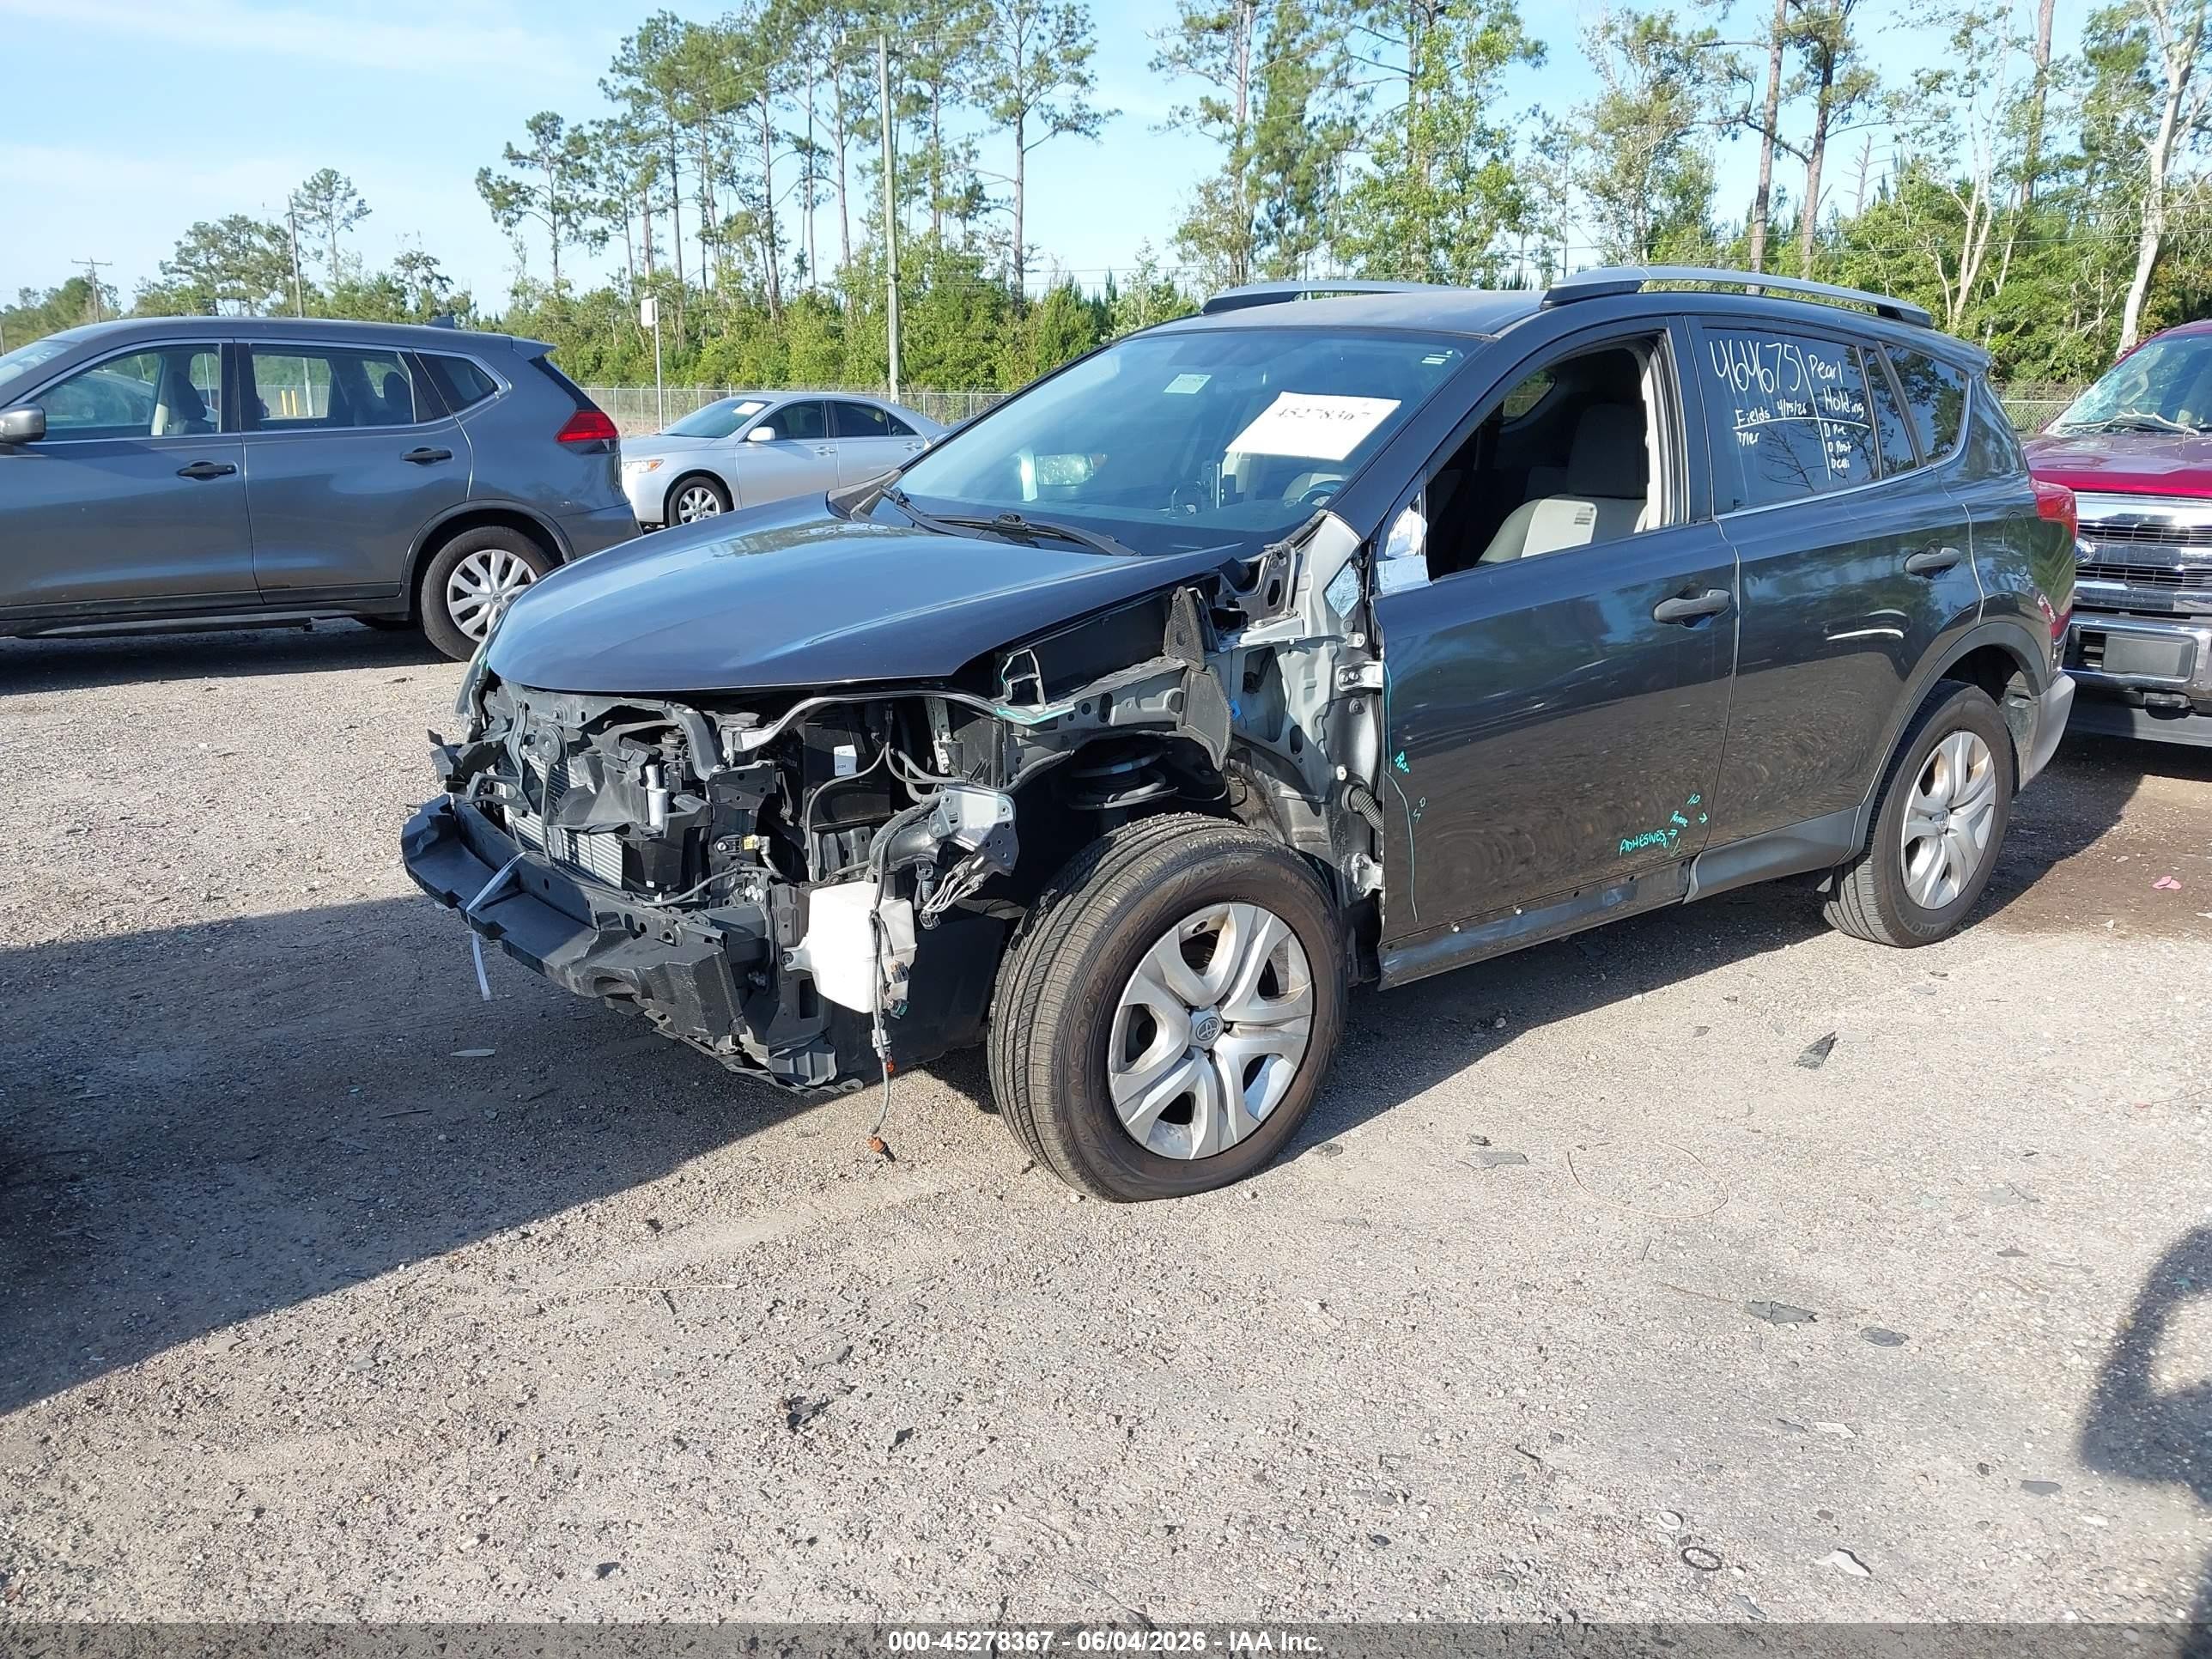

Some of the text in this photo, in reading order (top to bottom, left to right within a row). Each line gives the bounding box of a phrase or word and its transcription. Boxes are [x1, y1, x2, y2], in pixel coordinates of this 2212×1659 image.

[1710, 340, 1801, 393] 464675
[1808, 354, 1844, 385] Pearl
[1735, 406, 1771, 427] Fields
[1823, 385, 1864, 418] Holding
